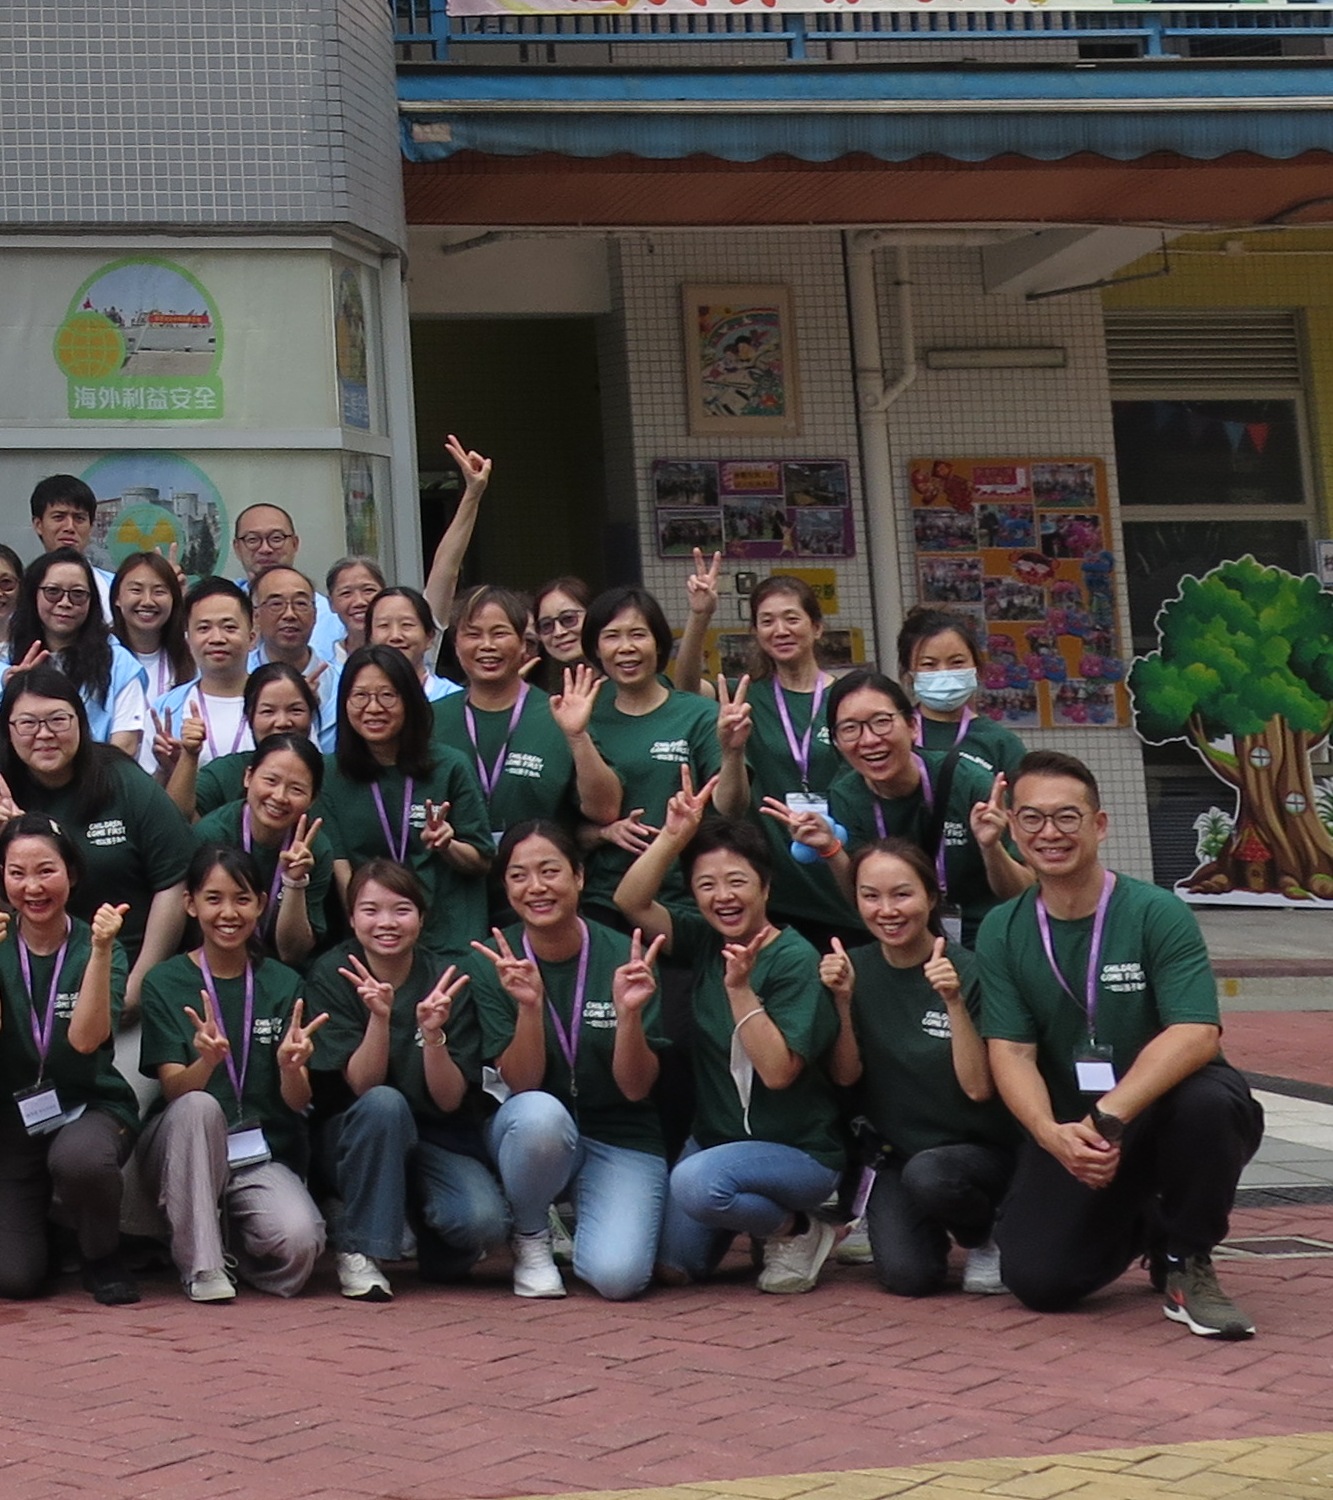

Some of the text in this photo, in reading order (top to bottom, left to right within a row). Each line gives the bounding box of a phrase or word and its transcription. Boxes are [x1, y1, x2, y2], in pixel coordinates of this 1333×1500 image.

[74, 386, 217, 410] 海外利益安全
